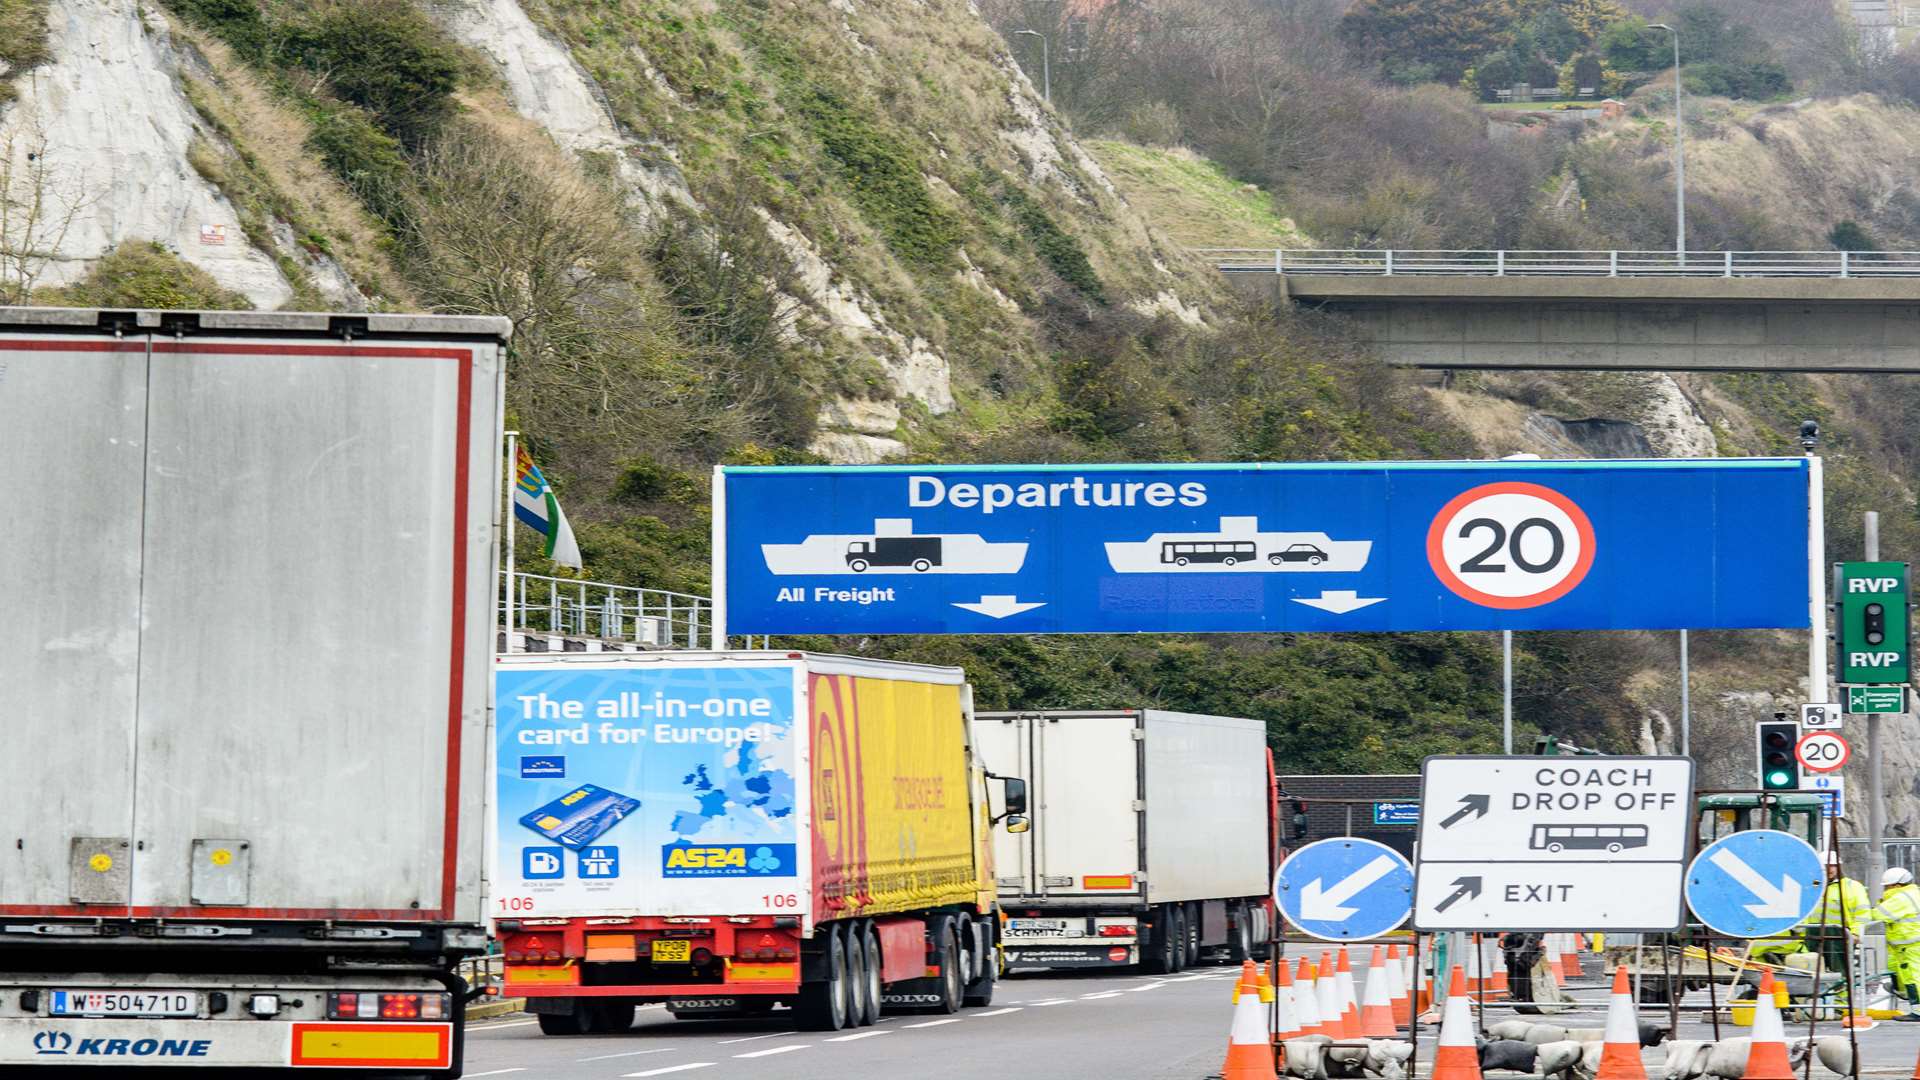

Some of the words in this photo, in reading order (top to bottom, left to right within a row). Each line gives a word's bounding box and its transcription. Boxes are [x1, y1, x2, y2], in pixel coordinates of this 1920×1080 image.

[908, 475, 1207, 514] Departures
[1458, 517, 1565, 573] 20
[1848, 577, 1898, 593] RVP
[776, 587, 804, 603] All
[814, 587, 895, 605] Freight
[1850, 652, 1900, 667] RVP
[517, 692, 584, 719] The
[597, 691, 771, 718] all-in-one
[518, 724, 590, 745] card
[598, 723, 647, 744] for
[654, 722, 773, 747] Europe!
[1806, 742, 1839, 761] 20
[1536, 768, 1652, 787] COACH
[1512, 792, 1601, 811] DROP
[1615, 792, 1676, 811] OFF
[666, 846, 746, 868] AS24
[761, 894, 798, 908] 106
[1505, 884, 1573, 902] EXIT
[498, 896, 535, 911] 106
[105, 994, 187, 1012] 50471D
[670, 998, 736, 1009] VOLVO
[880, 994, 941, 1003] VOLVO
[75, 1038, 212, 1057] KRONE
